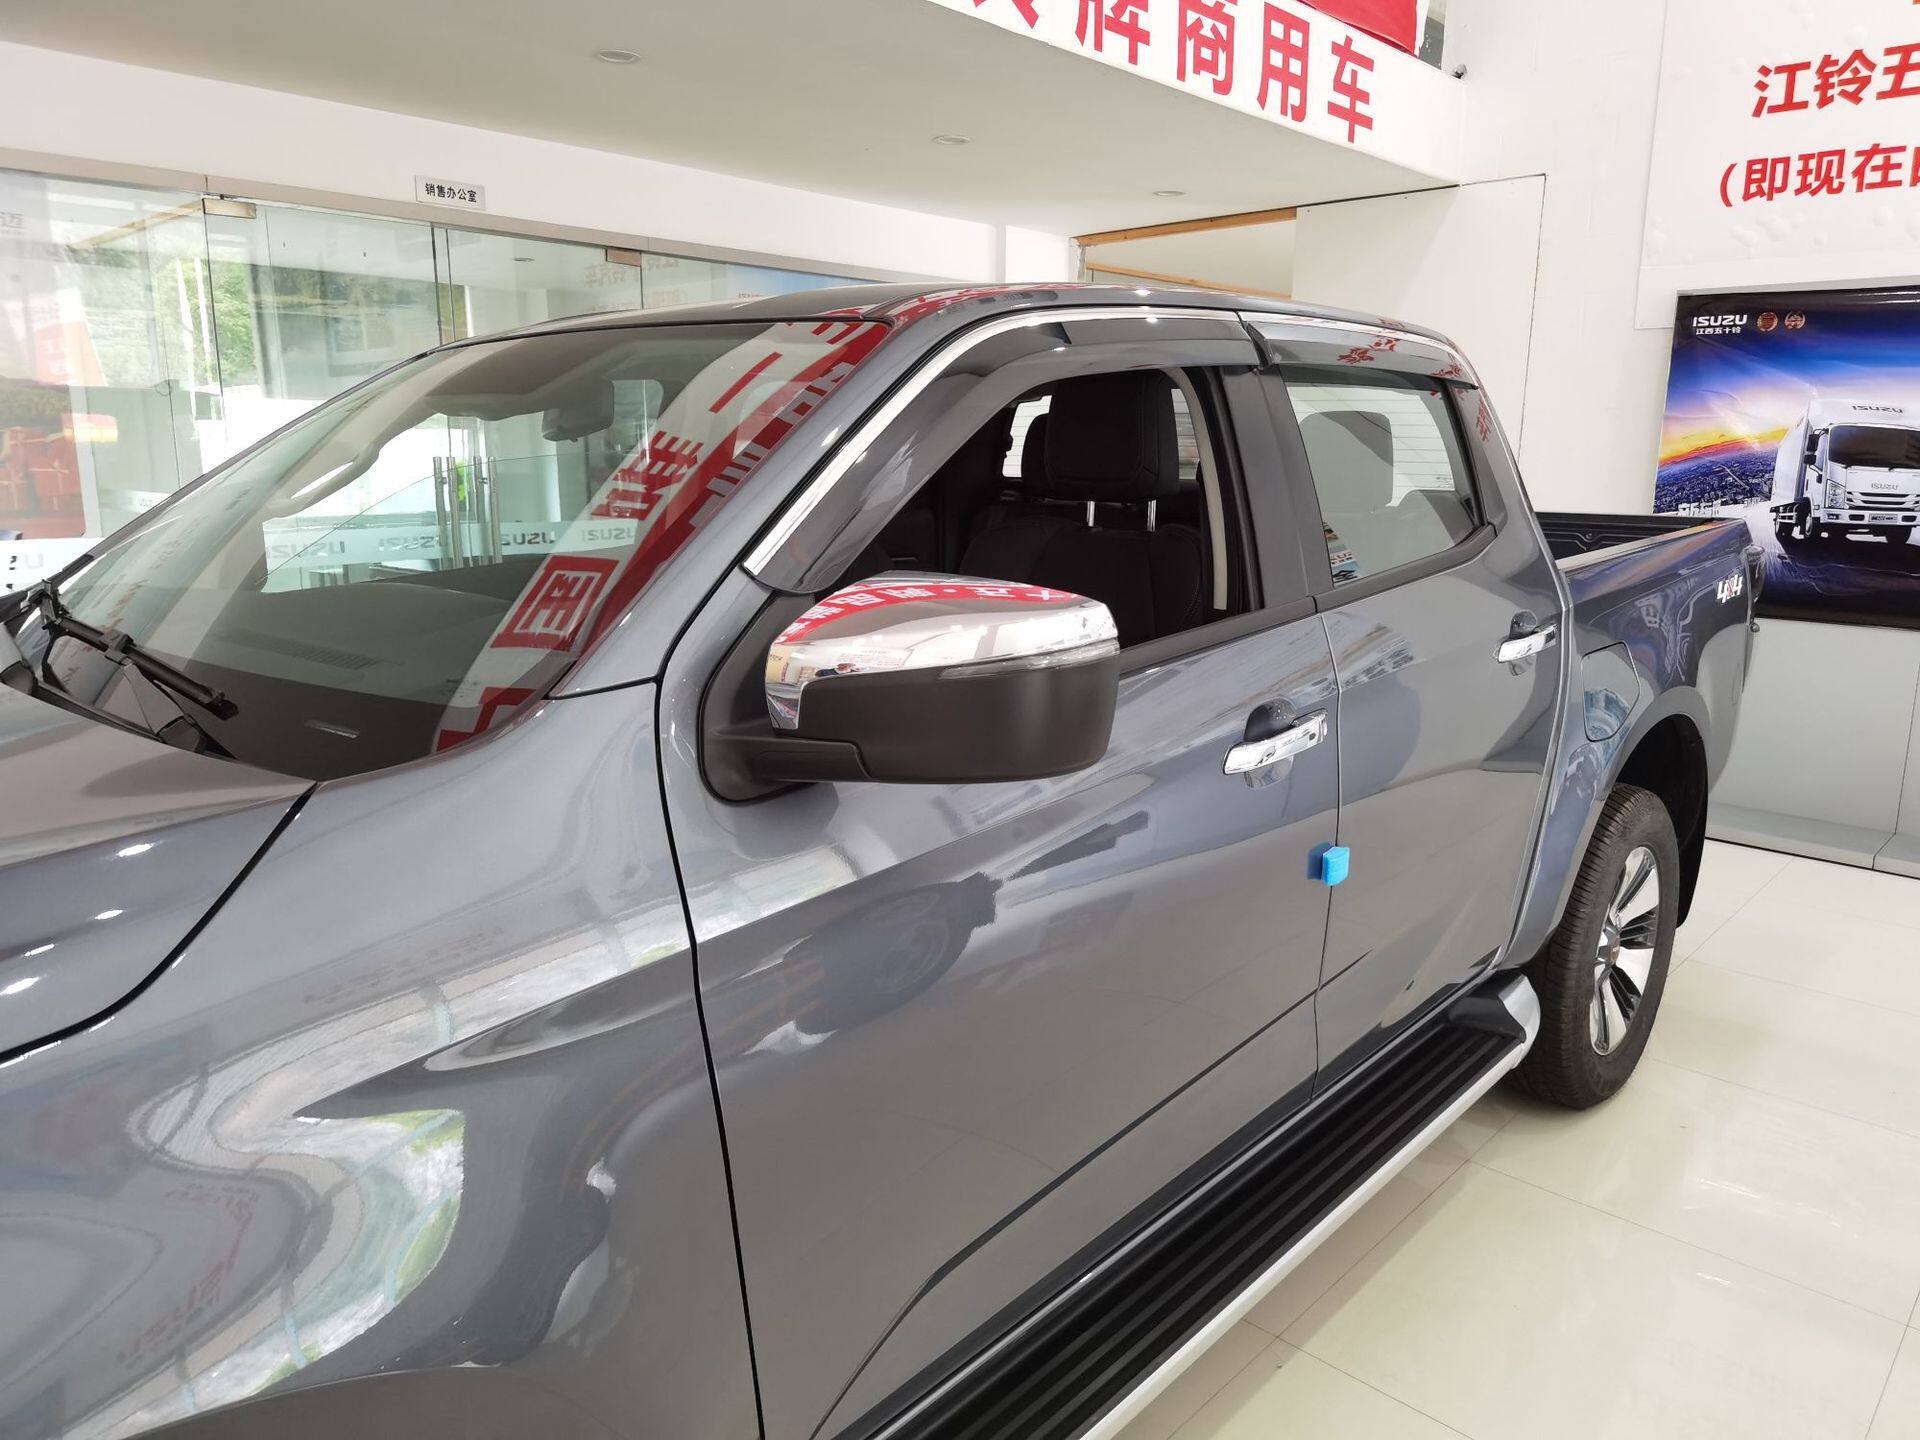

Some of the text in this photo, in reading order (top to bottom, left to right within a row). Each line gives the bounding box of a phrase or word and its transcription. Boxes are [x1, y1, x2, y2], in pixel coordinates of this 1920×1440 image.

[1719, 143, 1920, 207] (即现在
[425, 183, 477, 203] 销售办公室
[1692, 314, 1748, 327] ISUZU
[1852, 405, 1904, 413] ISUZU
